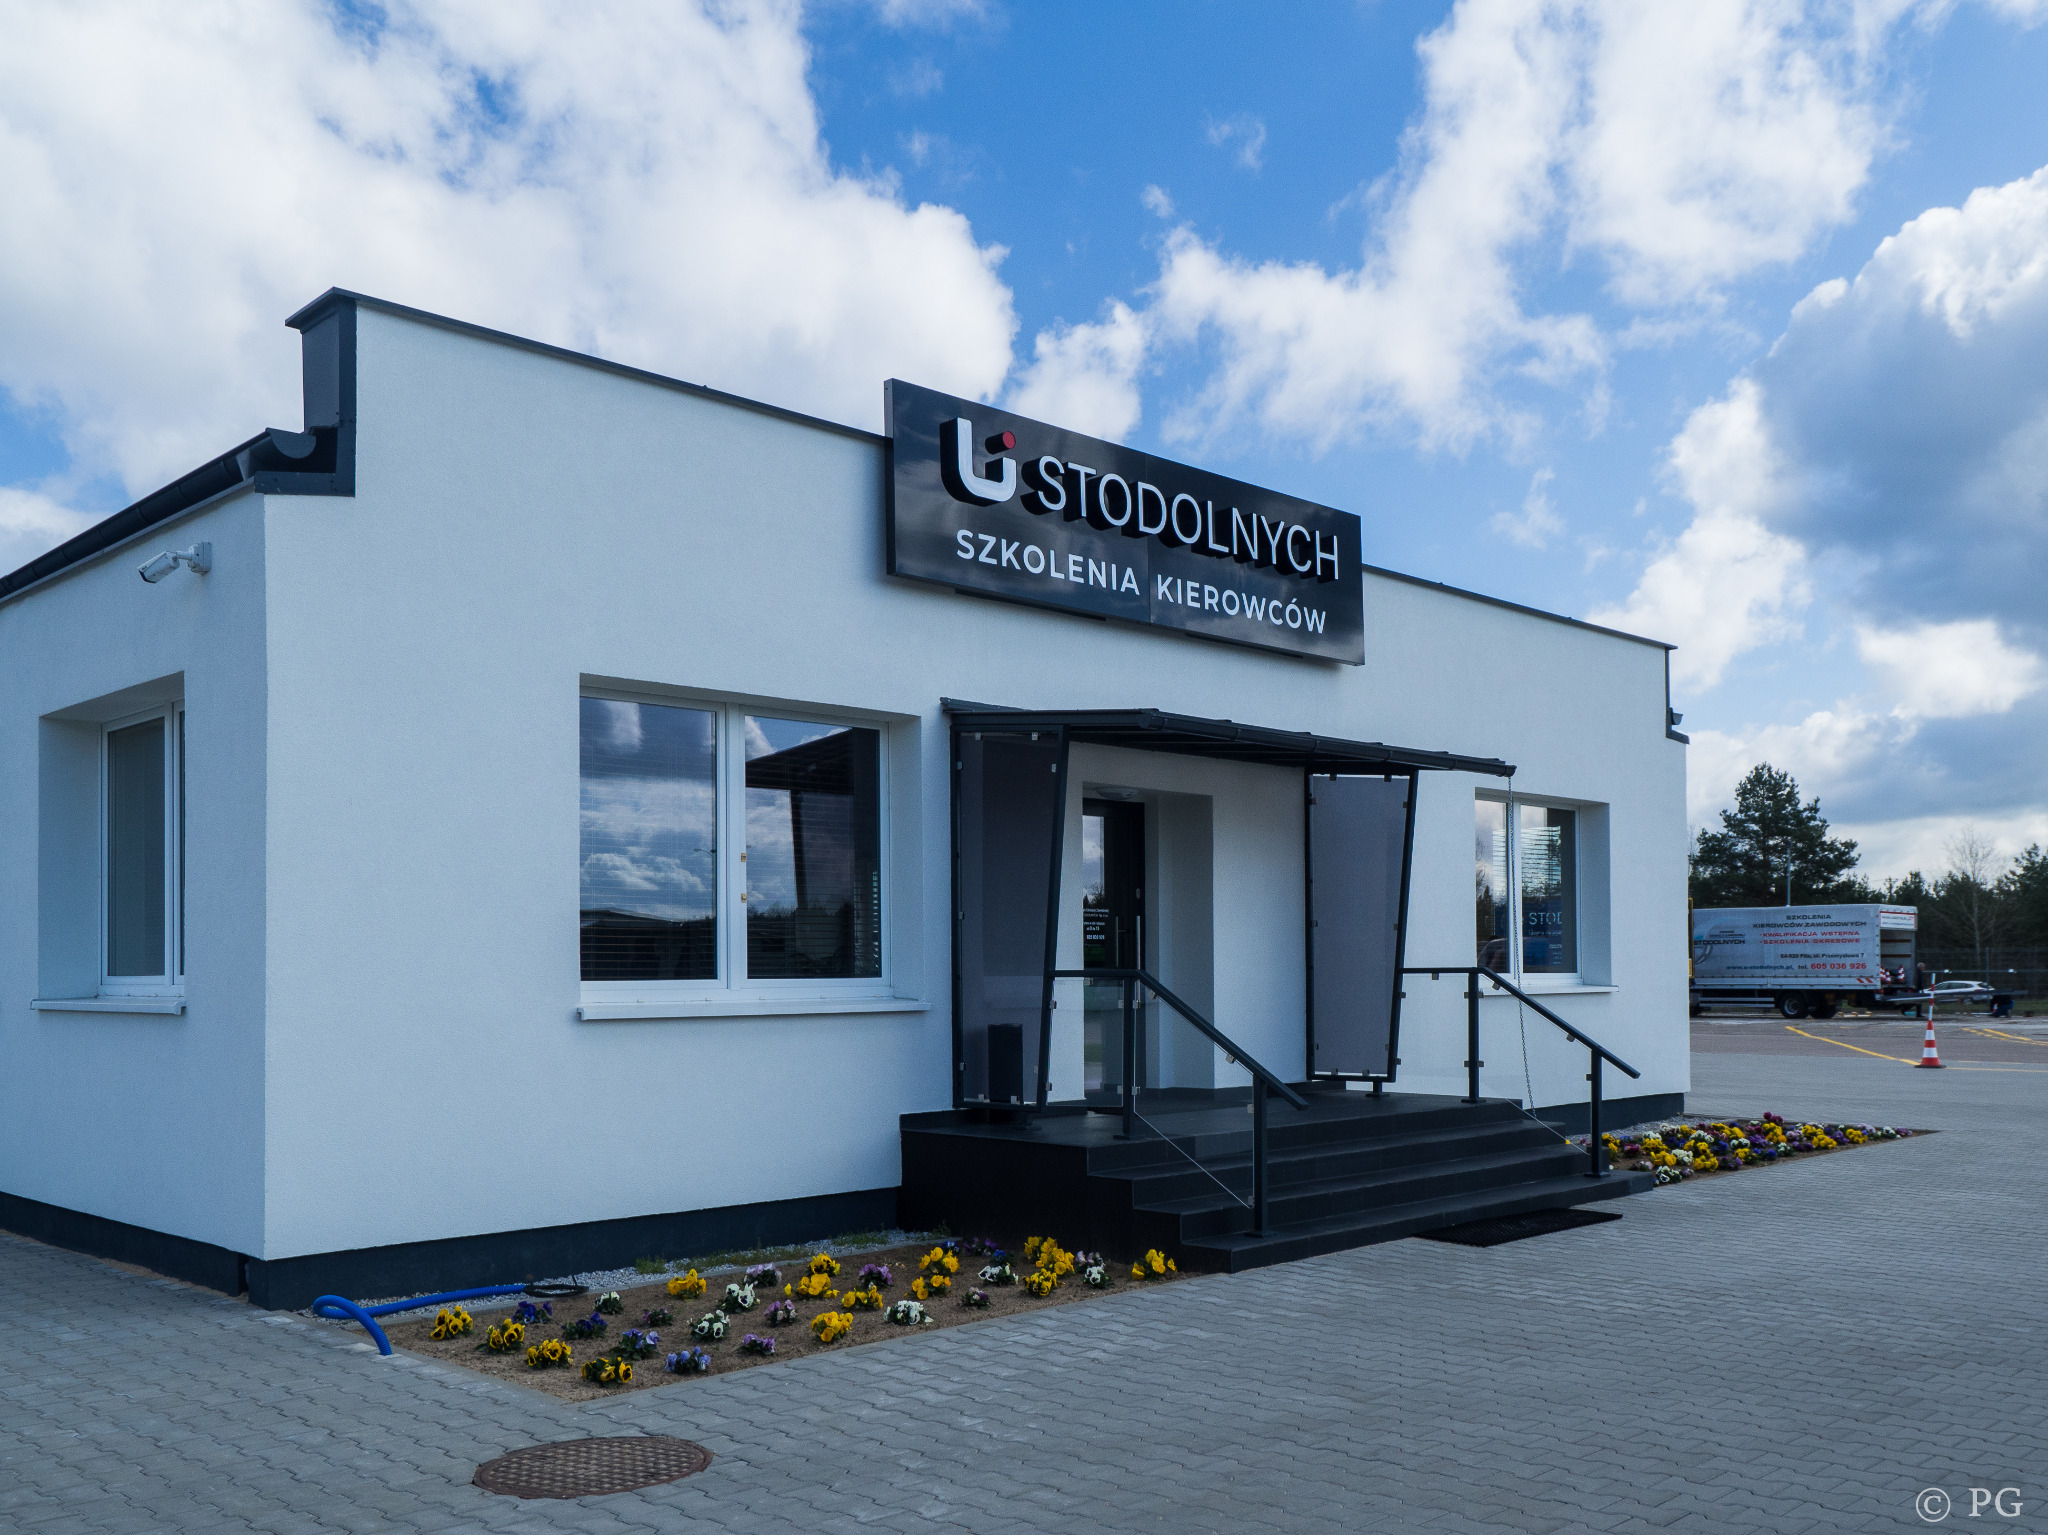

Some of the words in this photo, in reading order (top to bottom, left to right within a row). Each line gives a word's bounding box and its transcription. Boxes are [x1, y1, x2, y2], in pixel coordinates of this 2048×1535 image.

[1037, 454, 1339, 581] STODOLNYCH
[956, 528, 1141, 596] SZKOLENIA
[1157, 573, 1326, 635] KIEROWCÓW
